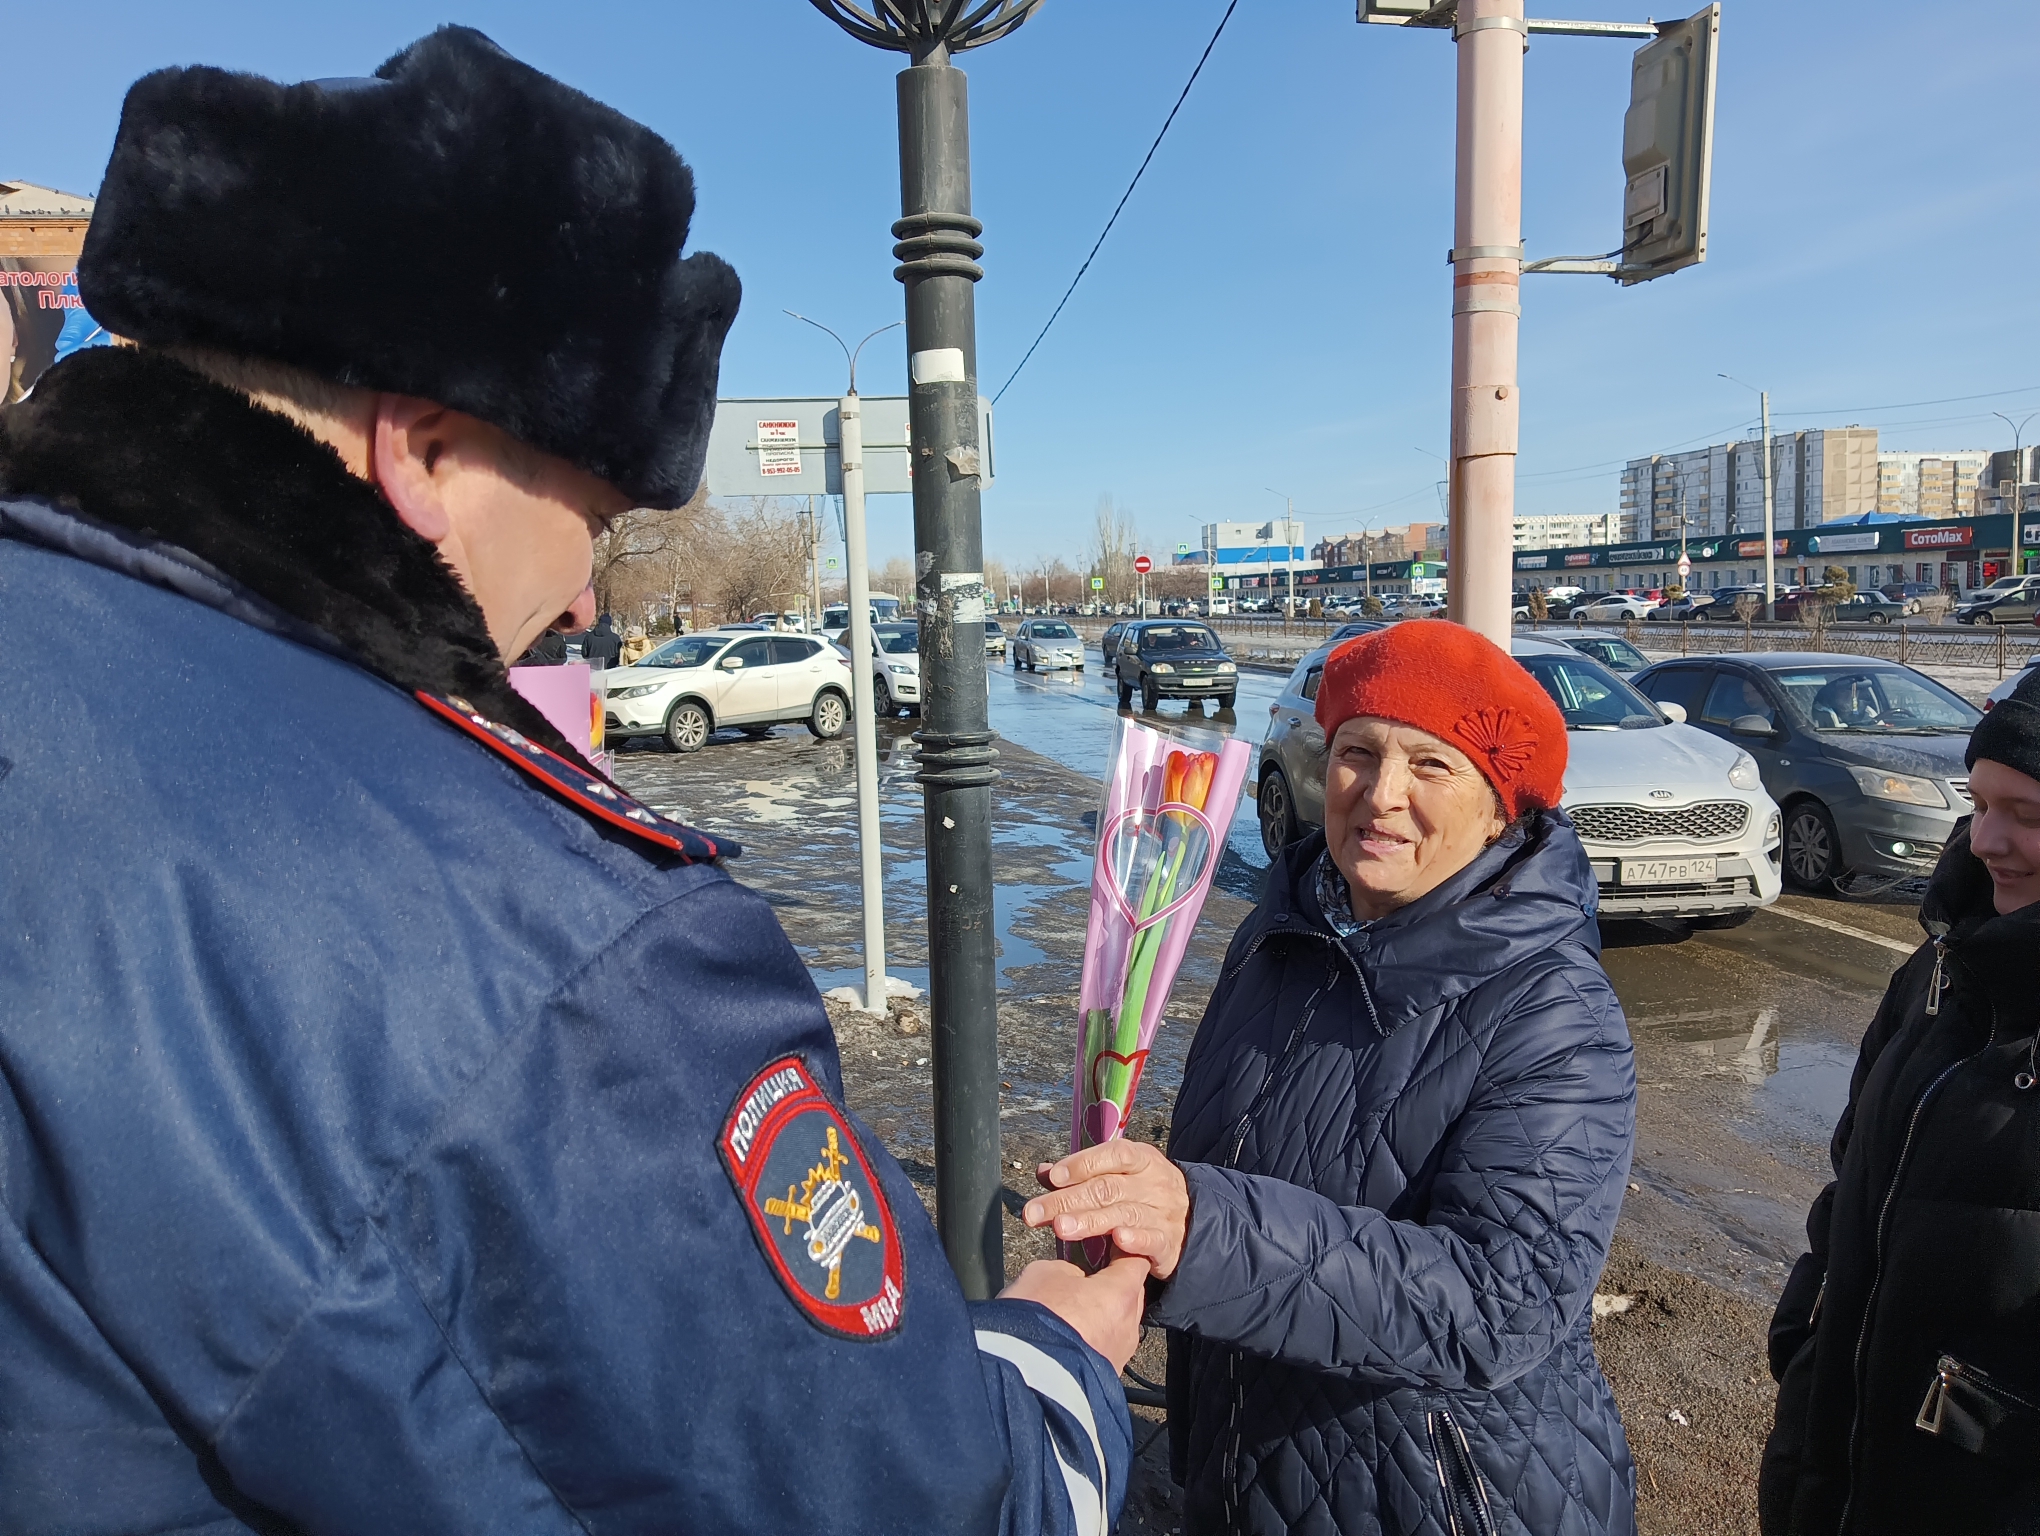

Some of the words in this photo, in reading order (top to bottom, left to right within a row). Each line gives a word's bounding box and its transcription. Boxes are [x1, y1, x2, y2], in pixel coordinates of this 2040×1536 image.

[1653, 790, 1671, 799] KIA
[1626, 862, 1688, 880] А747РВ
[1691, 860, 1713, 873] 124
[730, 1067, 805, 1163] ПОЛИЦИЯ
[859, 1274, 901, 1334] МВД
